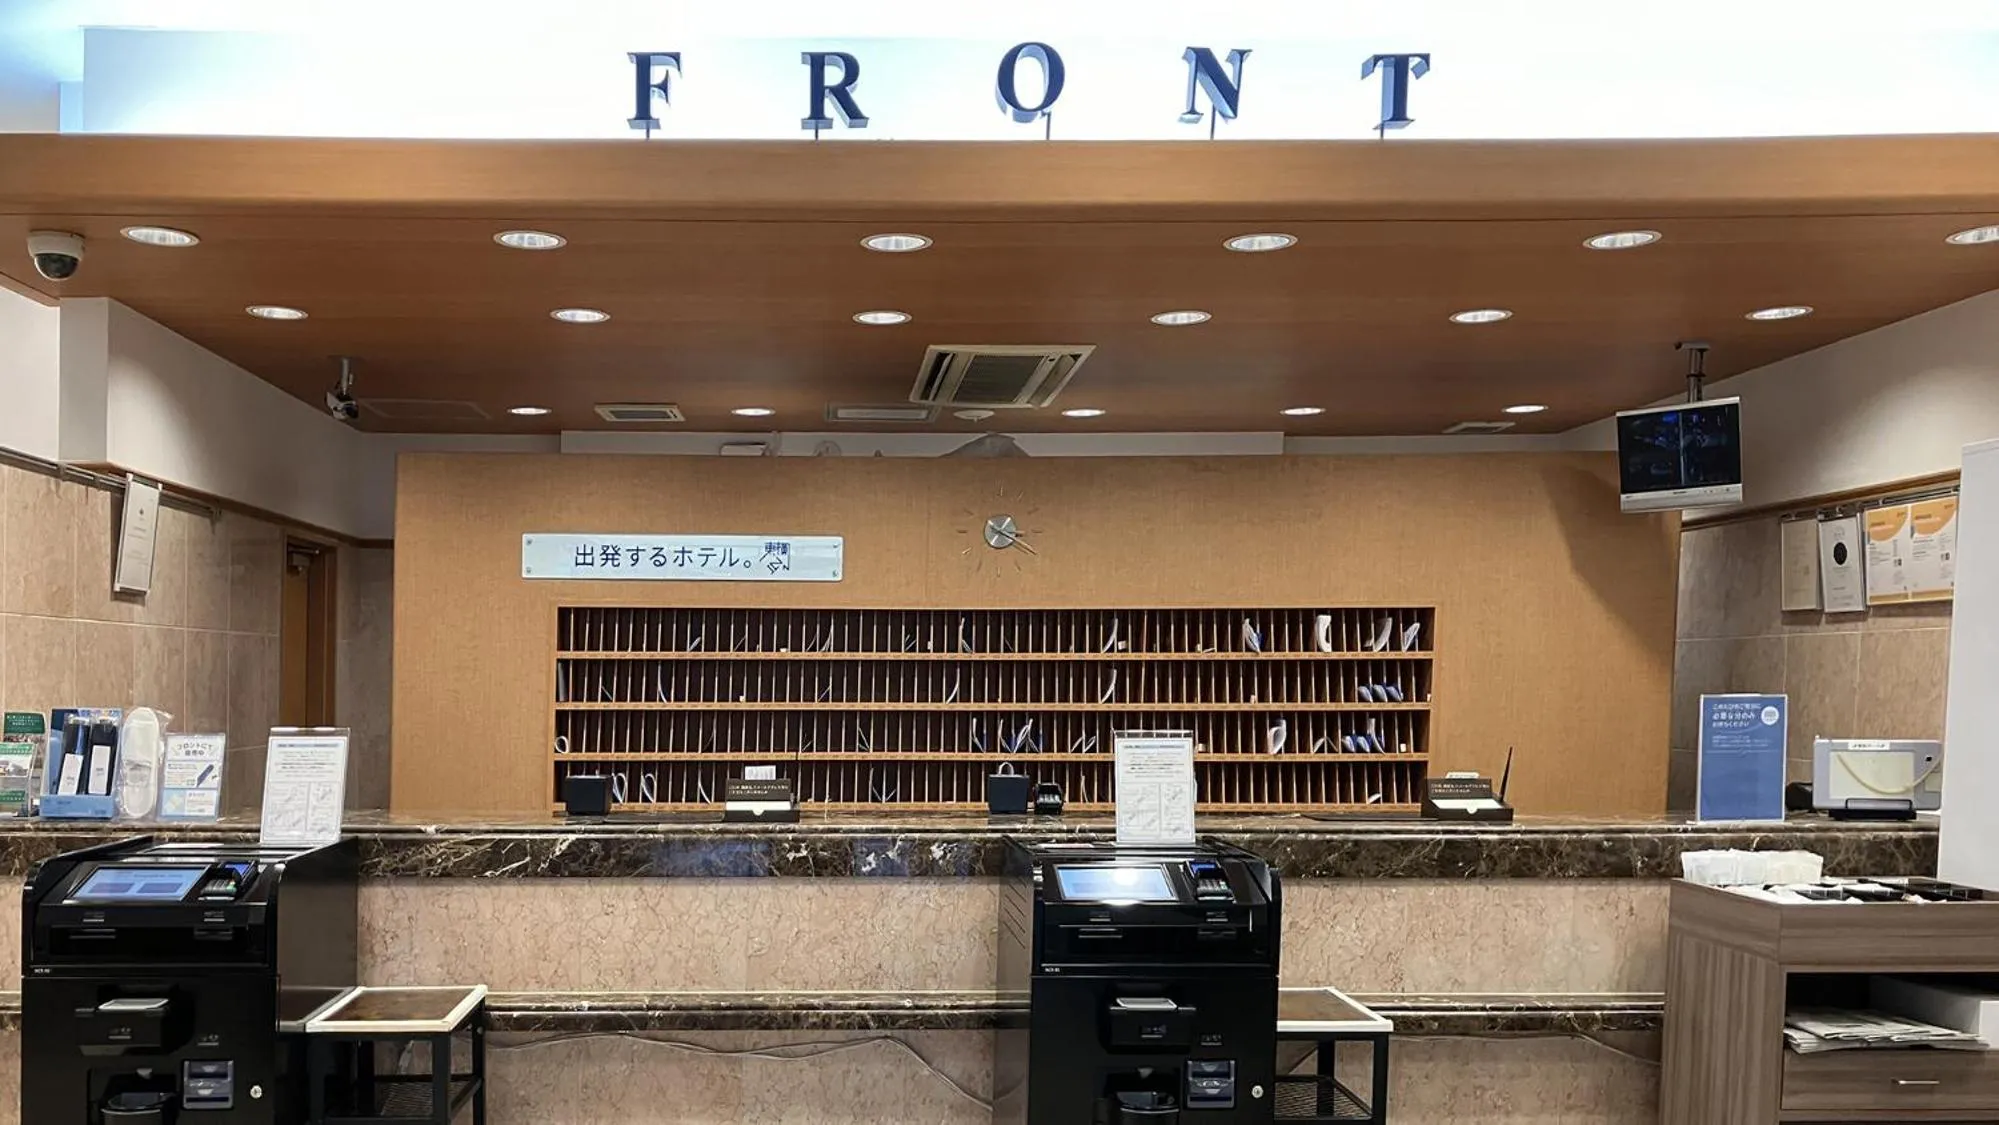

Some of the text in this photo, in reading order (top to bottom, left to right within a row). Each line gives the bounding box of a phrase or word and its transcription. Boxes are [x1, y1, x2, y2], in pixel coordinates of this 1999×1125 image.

[626, 41, 1432, 129] FRONT
[574, 543, 753, 569] 出発するホテル。
